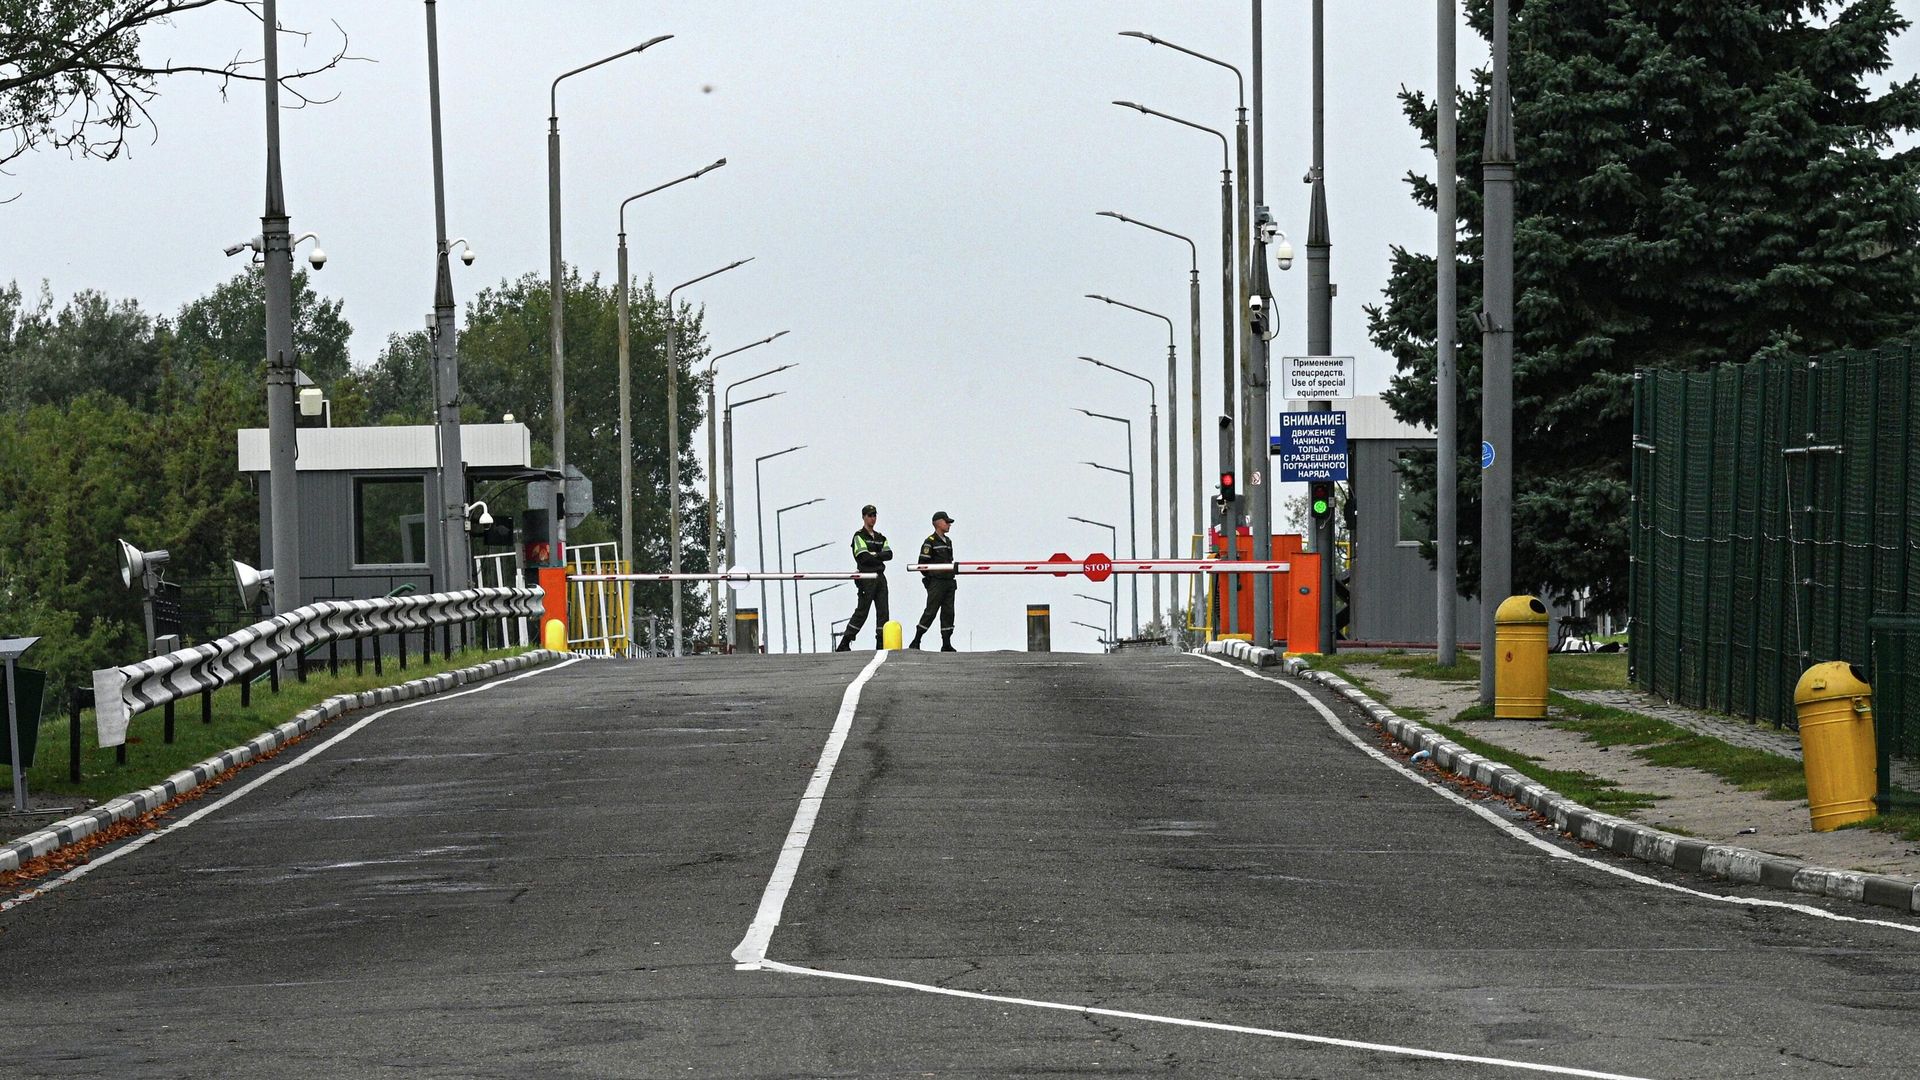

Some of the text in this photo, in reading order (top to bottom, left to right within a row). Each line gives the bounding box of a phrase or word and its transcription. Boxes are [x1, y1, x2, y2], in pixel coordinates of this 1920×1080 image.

[1293, 359, 1344, 368] Применение
[1292, 370, 1345, 378] спецсредств.
[1318, 379, 1345, 387] special
[1297, 389, 1339, 398] equipment.
[1283, 414, 1345, 426] ВНИМАНИЕ!
[1292, 429, 1335, 438] ДВИЖЕНИЕ
[1291, 454, 1345, 462] РАЗРЕШЕНИЯ
[1283, 462, 1345, 470] ПОГРАНИЧНОГО
[1298, 470, 1330, 478] НАРЯДА
[1085, 563, 1110, 572] STOP
